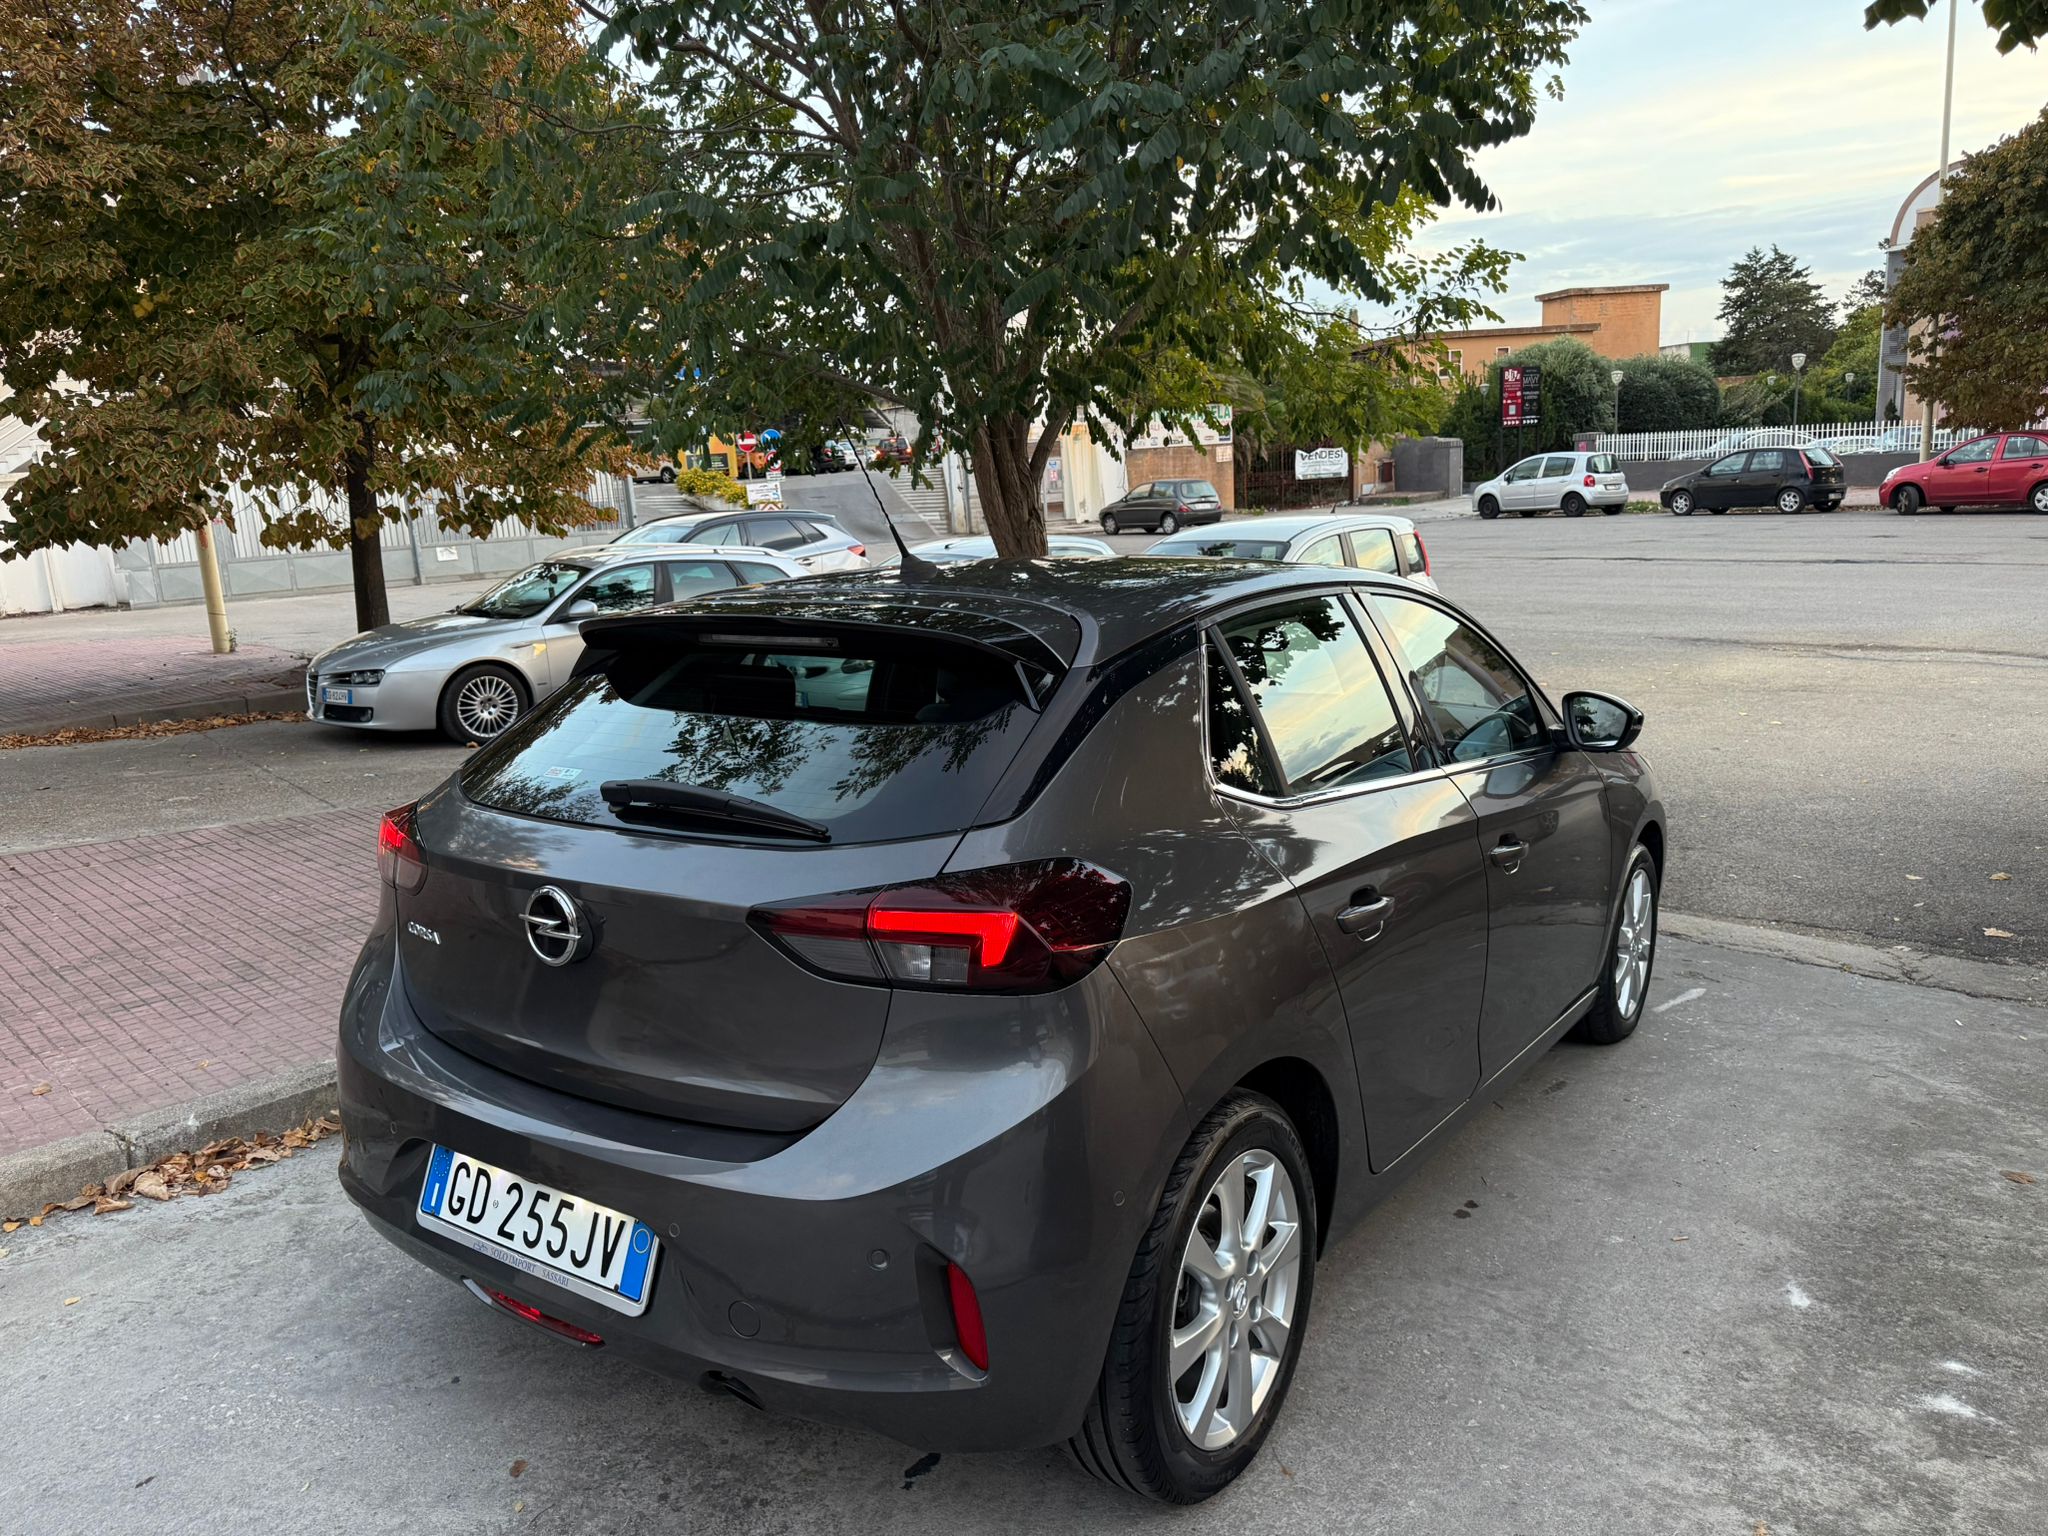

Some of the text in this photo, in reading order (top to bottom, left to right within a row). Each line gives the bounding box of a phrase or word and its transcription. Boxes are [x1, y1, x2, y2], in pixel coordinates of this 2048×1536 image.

[1300, 449, 1344, 461] VENDESI
[407, 921, 442, 945] CORSA
[448, 1161, 492, 1224] GD
[542, 1269, 570, 1288] SASSARI
